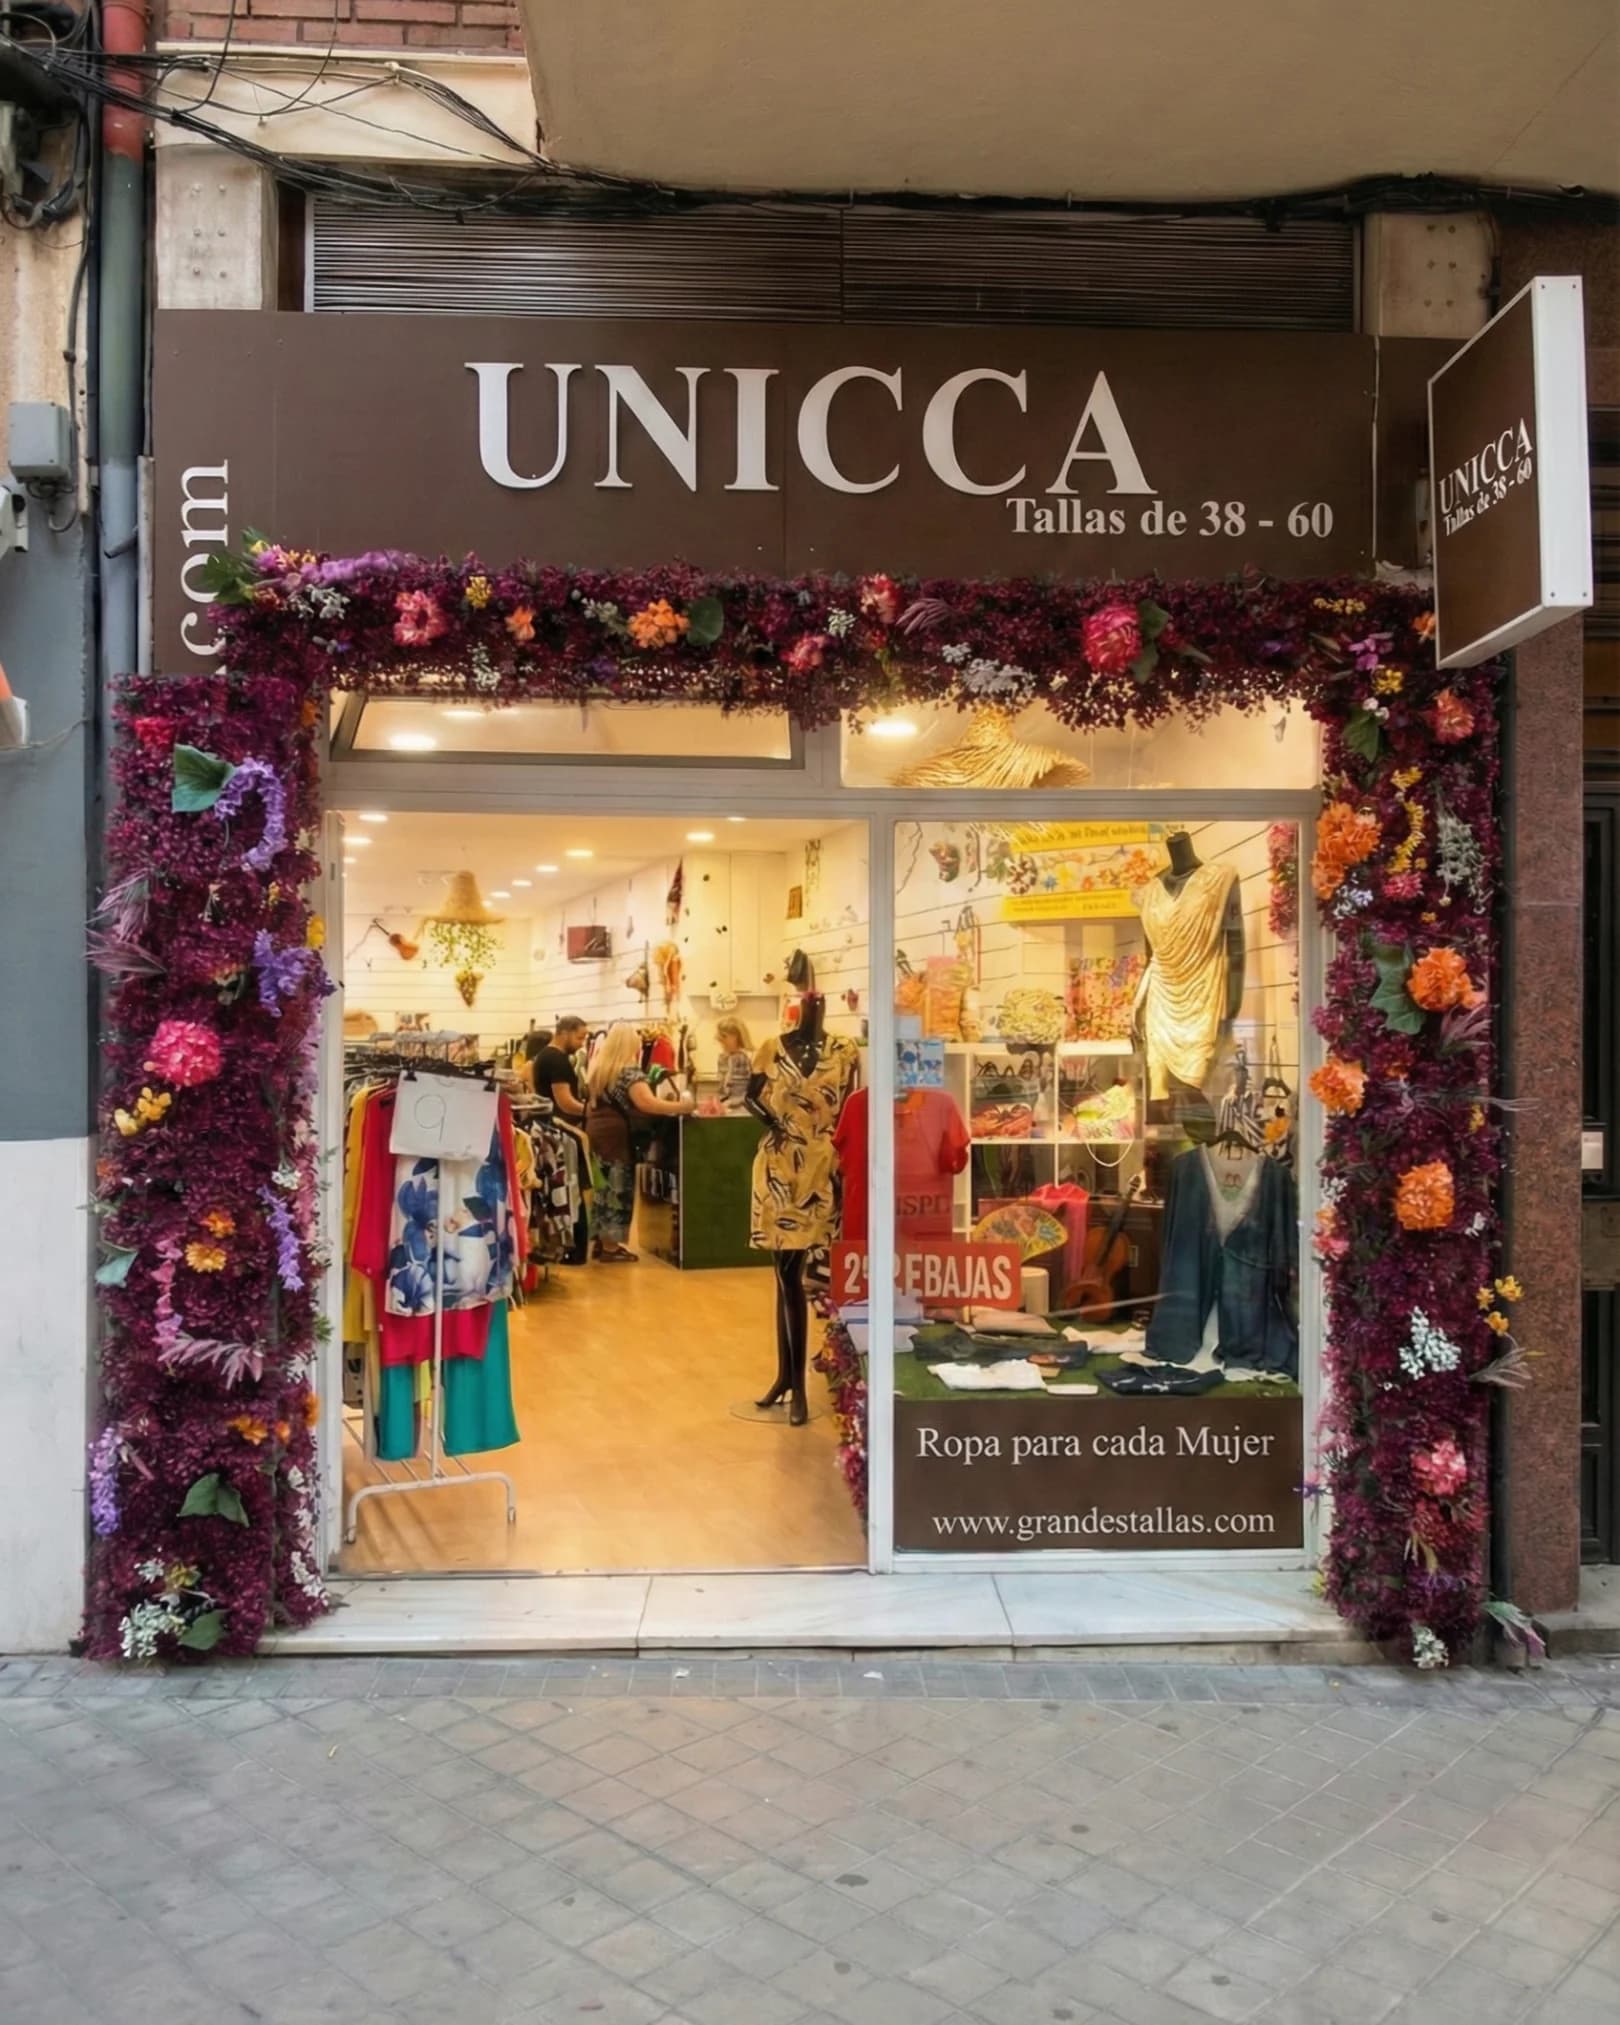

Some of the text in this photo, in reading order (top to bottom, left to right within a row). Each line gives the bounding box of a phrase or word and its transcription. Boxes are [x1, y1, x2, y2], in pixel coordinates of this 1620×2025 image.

[463, 361, 1158, 496] UNICCA
[1439, 417, 1533, 515] UNICCA
[1006, 498, 1126, 535] Tallas
[1140, 500, 1187, 536] de
[1199, 501, 1246, 537] 38
[1288, 503, 1334, 537] 60
[1444, 505, 1475, 537] Tallas
[1476, 491, 1490, 514] de
[1492, 475, 1507, 505] 38
[1516, 456, 1533, 485] 60
[916, 1425, 1275, 1465] Ropa para cada Mujer
[932, 1506, 1276, 1542] www.grandestallas.com
